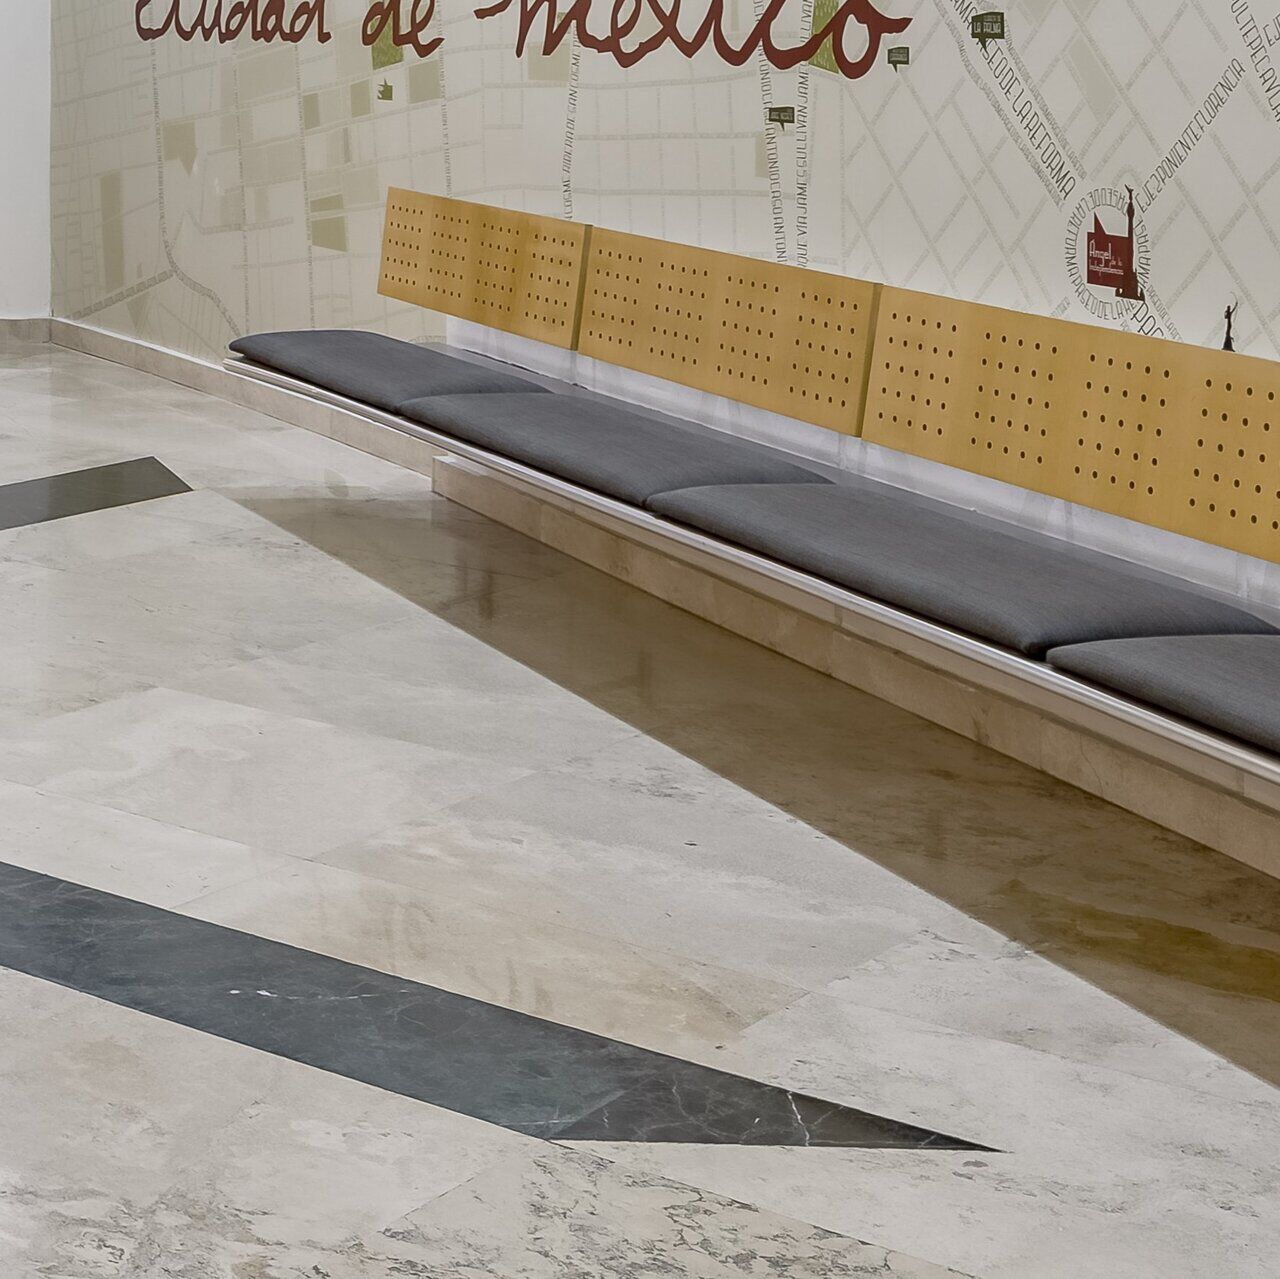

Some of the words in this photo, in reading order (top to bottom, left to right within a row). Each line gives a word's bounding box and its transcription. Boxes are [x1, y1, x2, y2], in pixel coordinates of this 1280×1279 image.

[997, 67, 1022, 101] DE
[1010, 89, 1034, 123] LA
[1153, 119, 1202, 186] PONIENTE
[1191, 57, 1248, 133] FLORENCIA
[1018, 111, 1081, 201] REFORMA
[772, 215, 788, 262] ANTONI
[1089, 239, 1111, 267] Ángel
